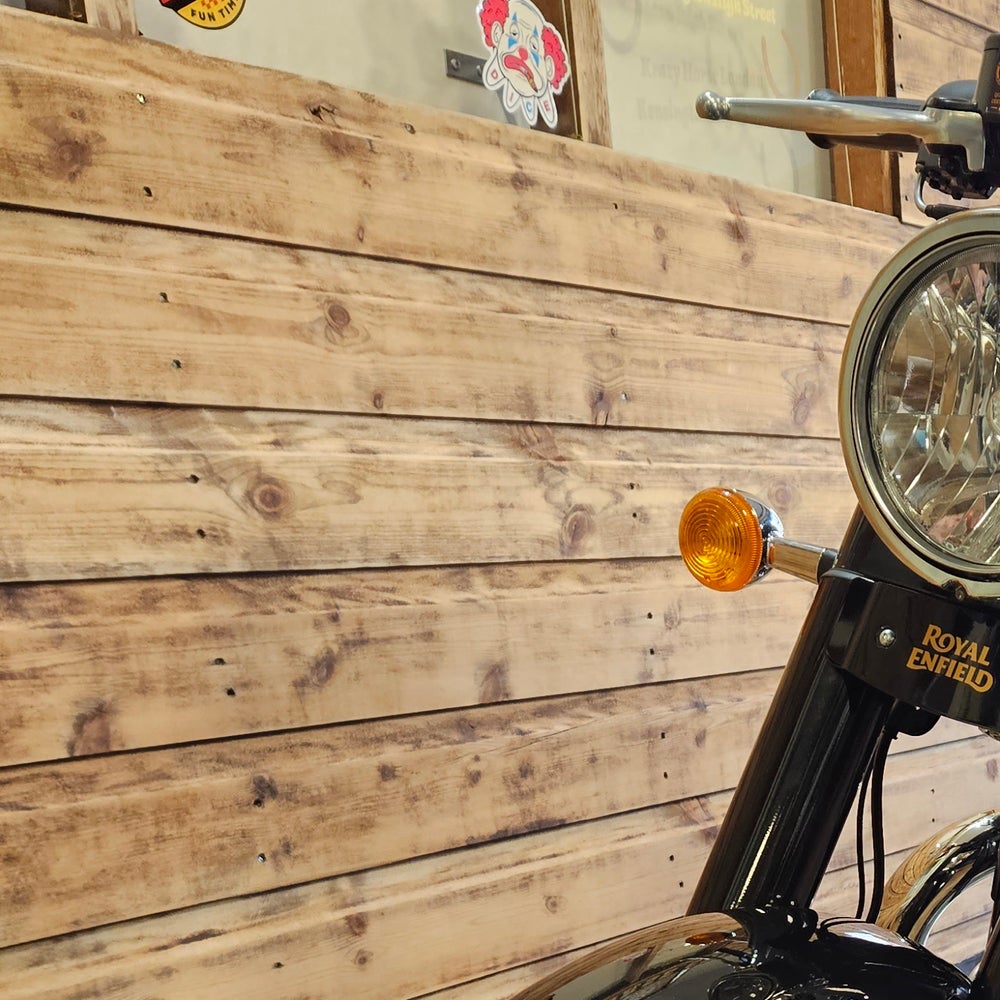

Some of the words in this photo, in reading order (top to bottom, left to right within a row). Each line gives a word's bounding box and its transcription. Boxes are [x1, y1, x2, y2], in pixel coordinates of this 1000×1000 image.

[190, 8, 216, 22] FUN
[217, 0, 241, 18] TIM
[922, 623, 990, 667] ROYAL
[905, 646, 994, 693] ENFIELD
